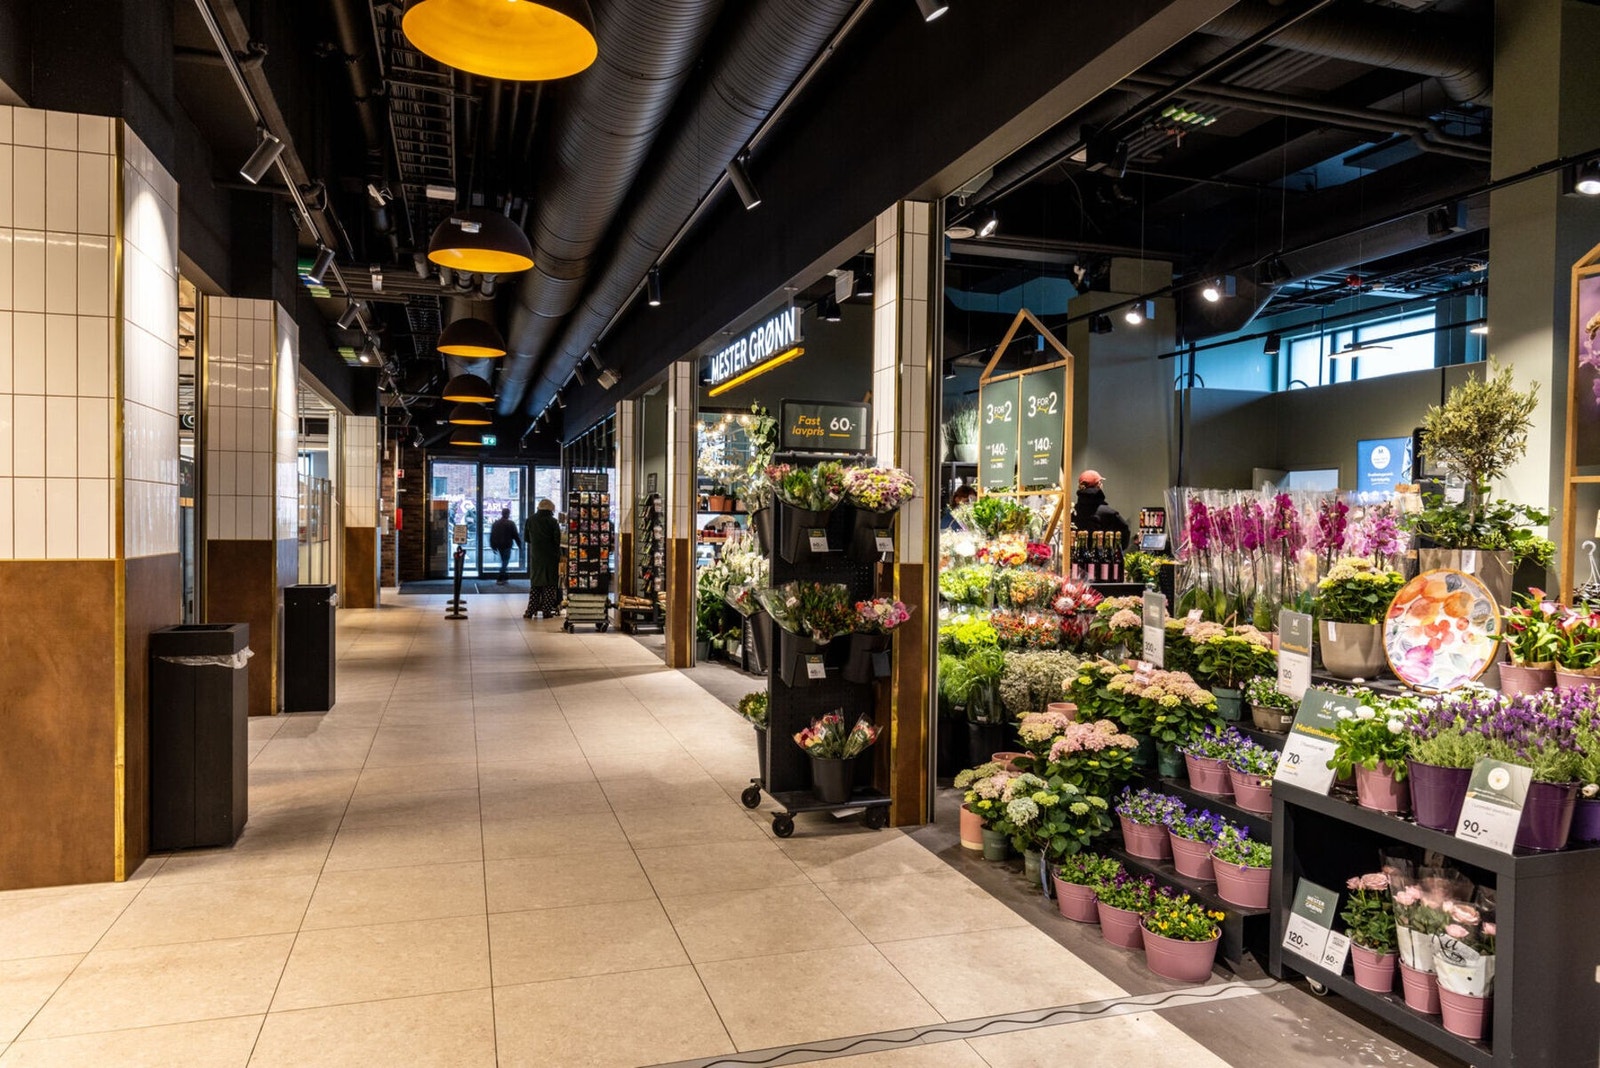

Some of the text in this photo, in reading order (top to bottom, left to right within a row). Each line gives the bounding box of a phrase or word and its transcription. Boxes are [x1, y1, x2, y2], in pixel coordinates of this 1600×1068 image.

[711, 306, 795, 384] MESTER GRØNN
[986, 404, 994, 424] 3
[1004, 401, 1012, 422] 2
[1028, 396, 1037, 417] 3
[1048, 392, 1057, 414] 2
[798, 415, 821, 426] Fast
[830, 417, 856, 431] 60,-
[792, 425, 825, 437] lavpris
[1463, 819, 1488, 836] 90,-
[1289, 931, 1309, 948] 120,-
